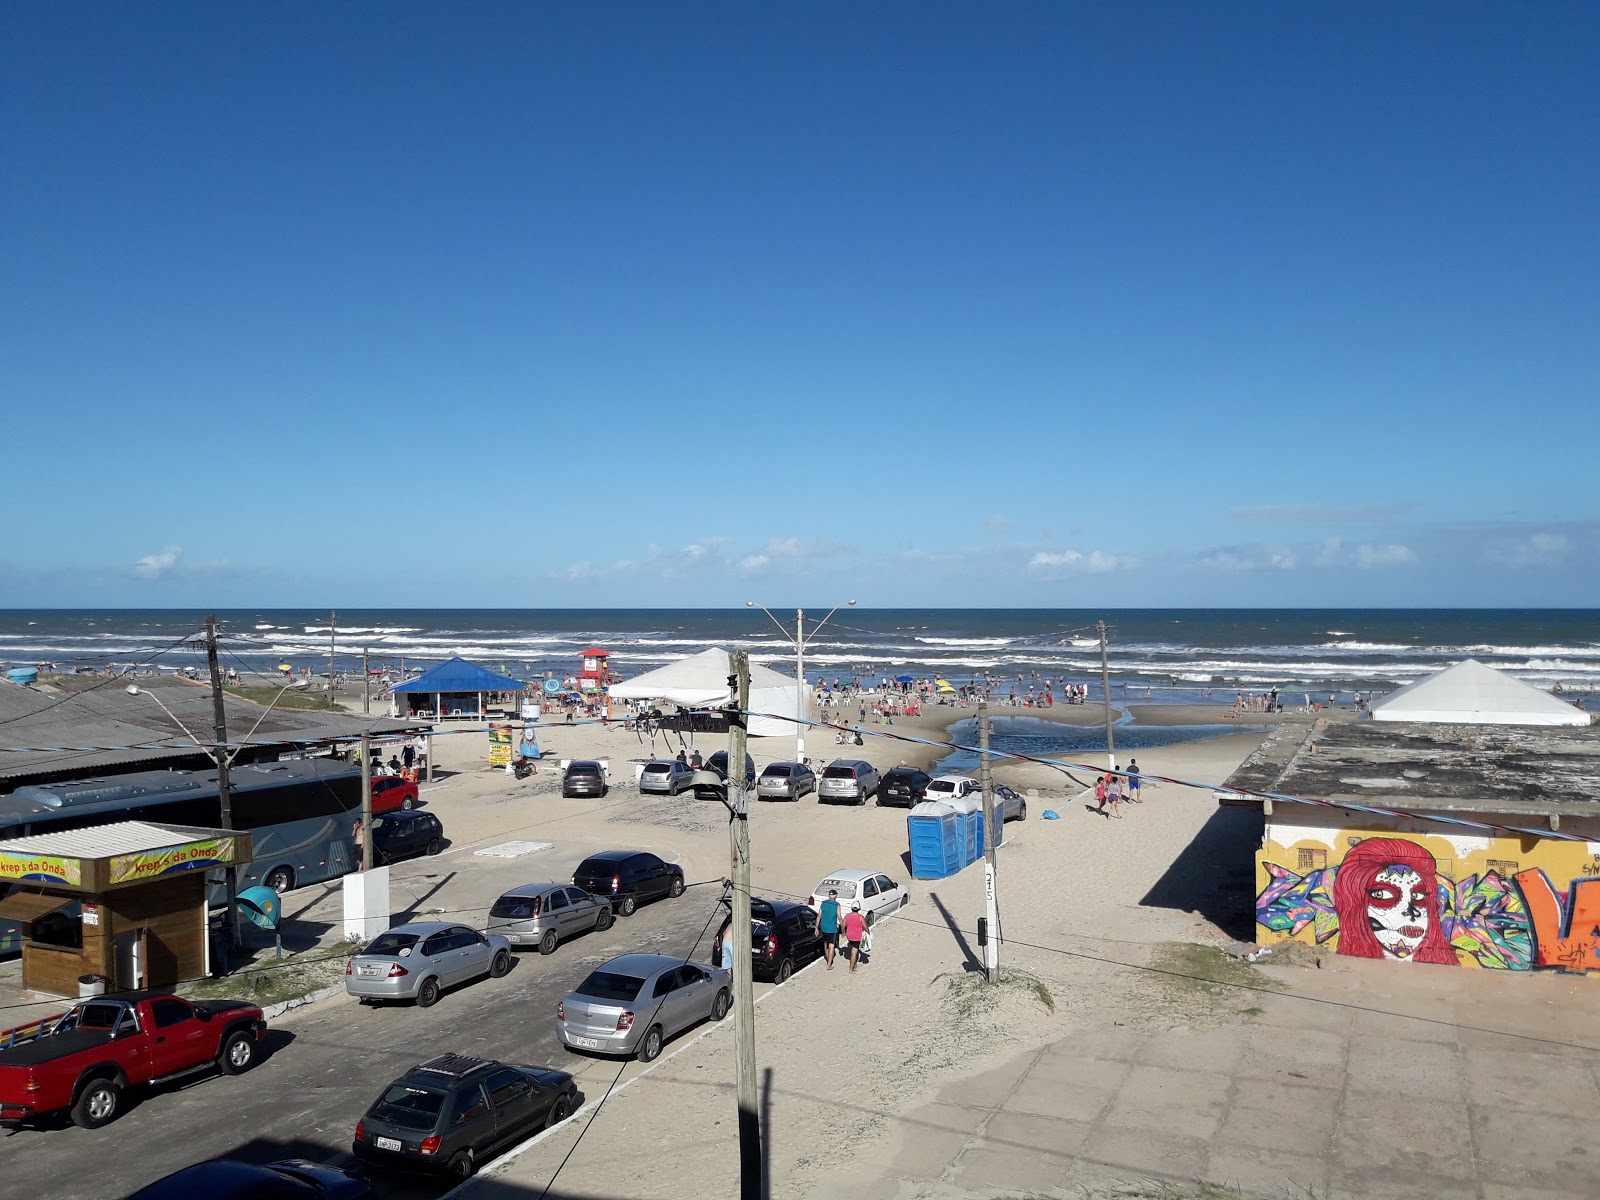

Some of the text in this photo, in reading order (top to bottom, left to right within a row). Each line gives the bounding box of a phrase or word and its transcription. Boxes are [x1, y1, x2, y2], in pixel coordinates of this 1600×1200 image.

[173, 851, 187, 862] da
[190, 847, 218, 859] Onda
[28, 860, 39, 872] da
[42, 861, 66, 876] Onda
